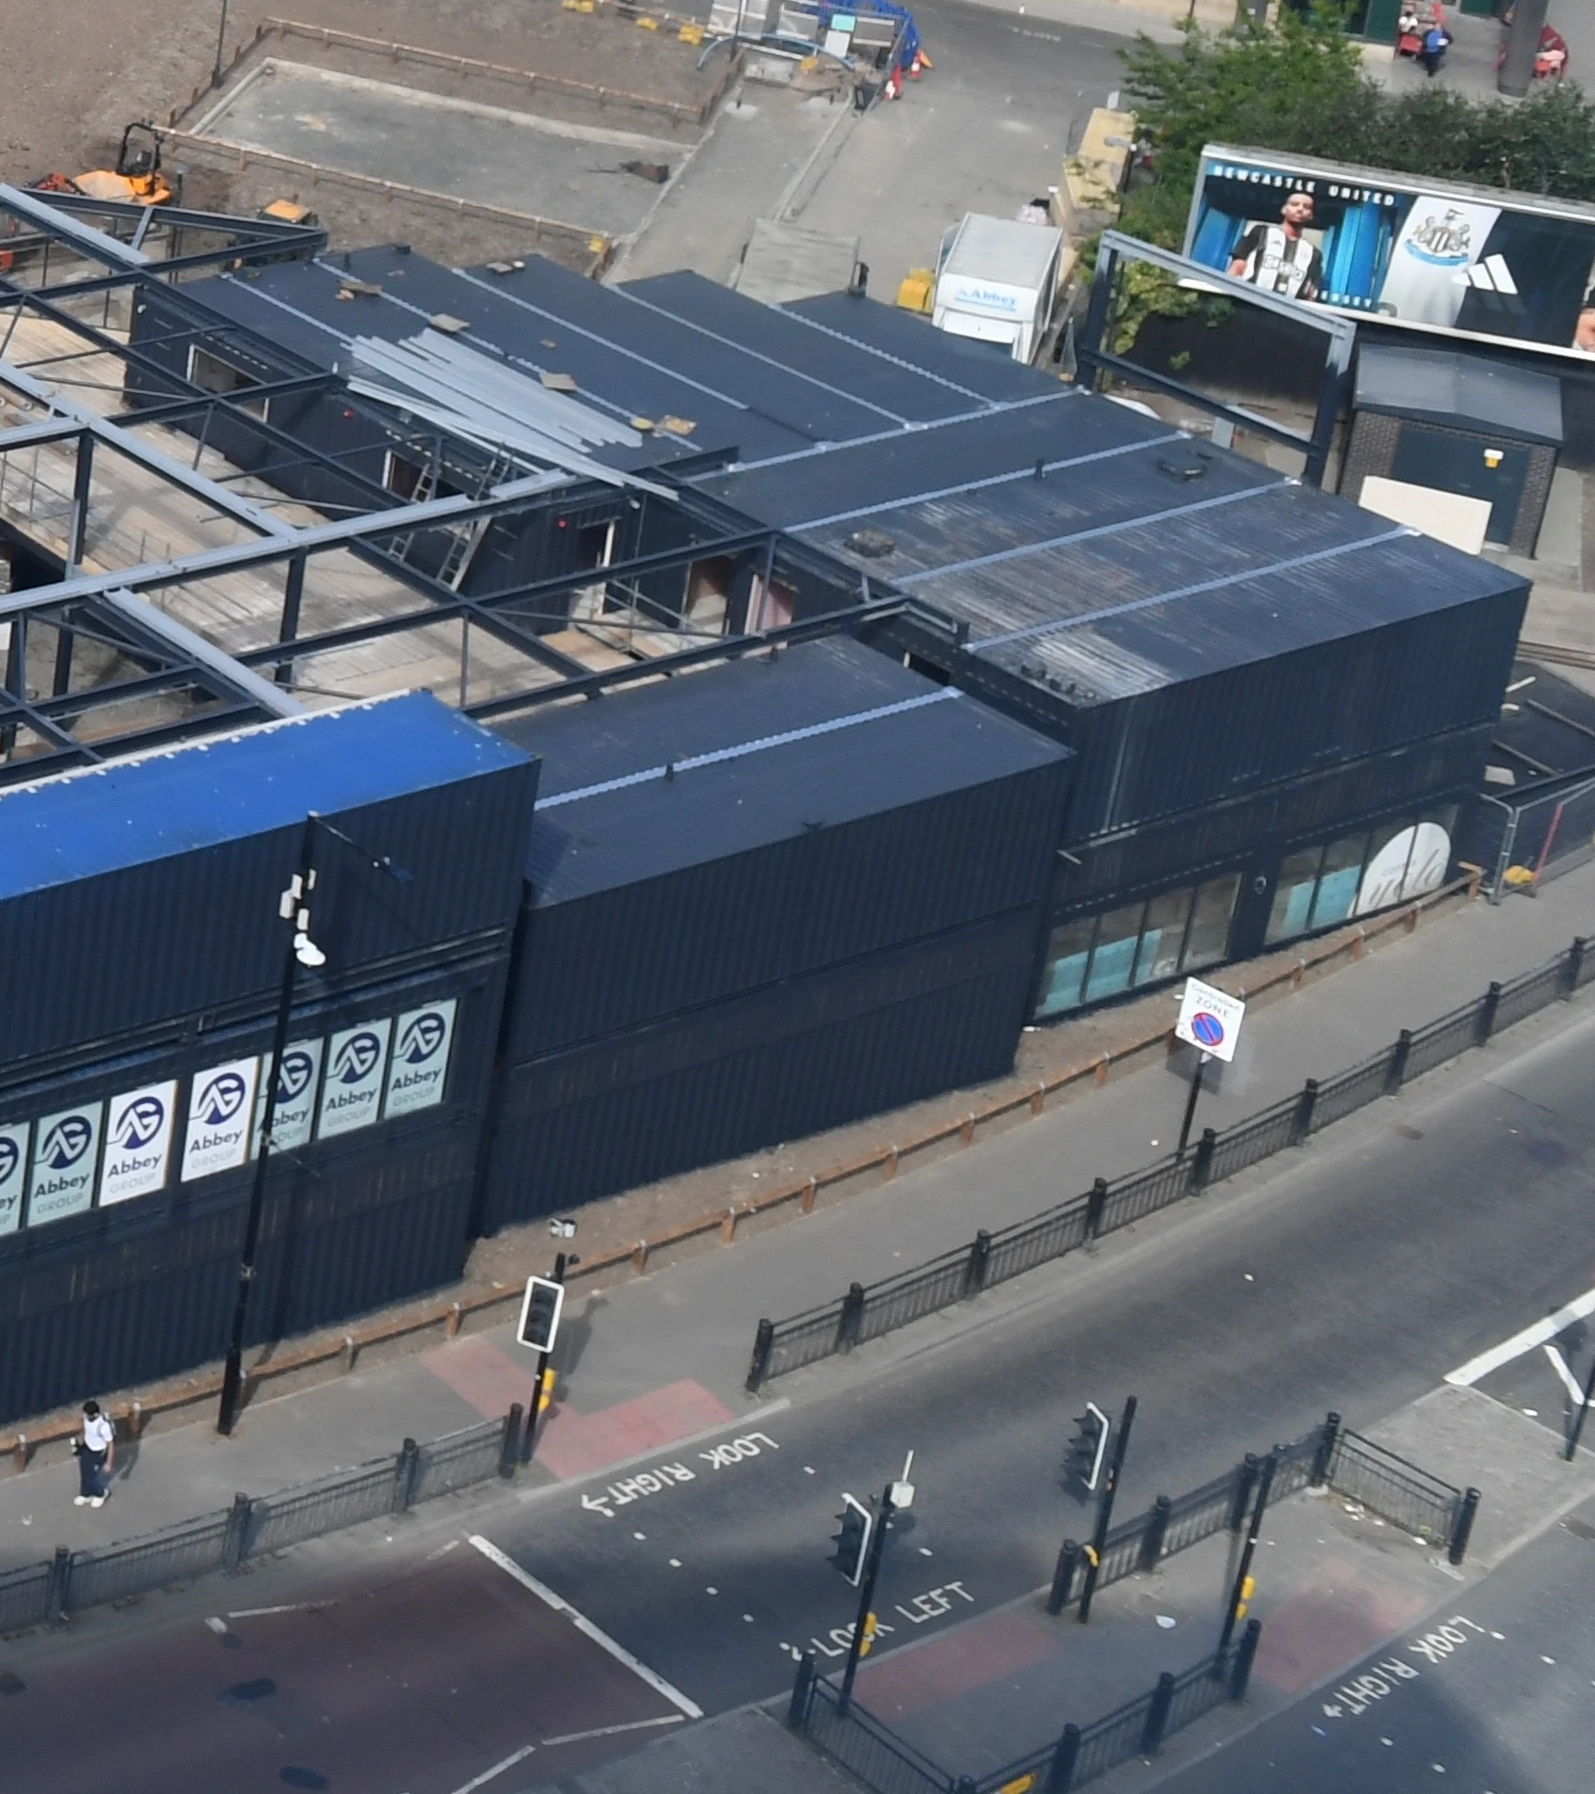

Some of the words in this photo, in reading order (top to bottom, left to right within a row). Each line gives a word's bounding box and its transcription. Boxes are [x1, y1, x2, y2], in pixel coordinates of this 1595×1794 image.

[1213, 165, 1316, 193] NEWCASTLE
[1328, 185, 1396, 206] UNITED
[1195, 996, 1228, 1017] ZONE
[391, 1068, 442, 1092] Abbey
[325, 1087, 378, 1112] Abbey
[393, 1086, 435, 1107] GROUP
[327, 1106, 371, 1127] GROUP
[189, 1129, 243, 1153] Abbey
[107, 1154, 163, 1178] Abbey
[191, 1148, 237, 1169] GROUP
[33, 1173, 90, 1199] Abbey
[110, 1172, 156, 1194] GROUP
[37, 1192, 84, 1214] GROUP
[698, 1432, 780, 1470] LOOK
[607, 1462, 696, 1506] RIGHT
[895, 1581, 975, 1624] LEFT
[1407, 1615, 1486, 1664] LOOK
[1333, 1657, 1420, 1716] RIGHT
